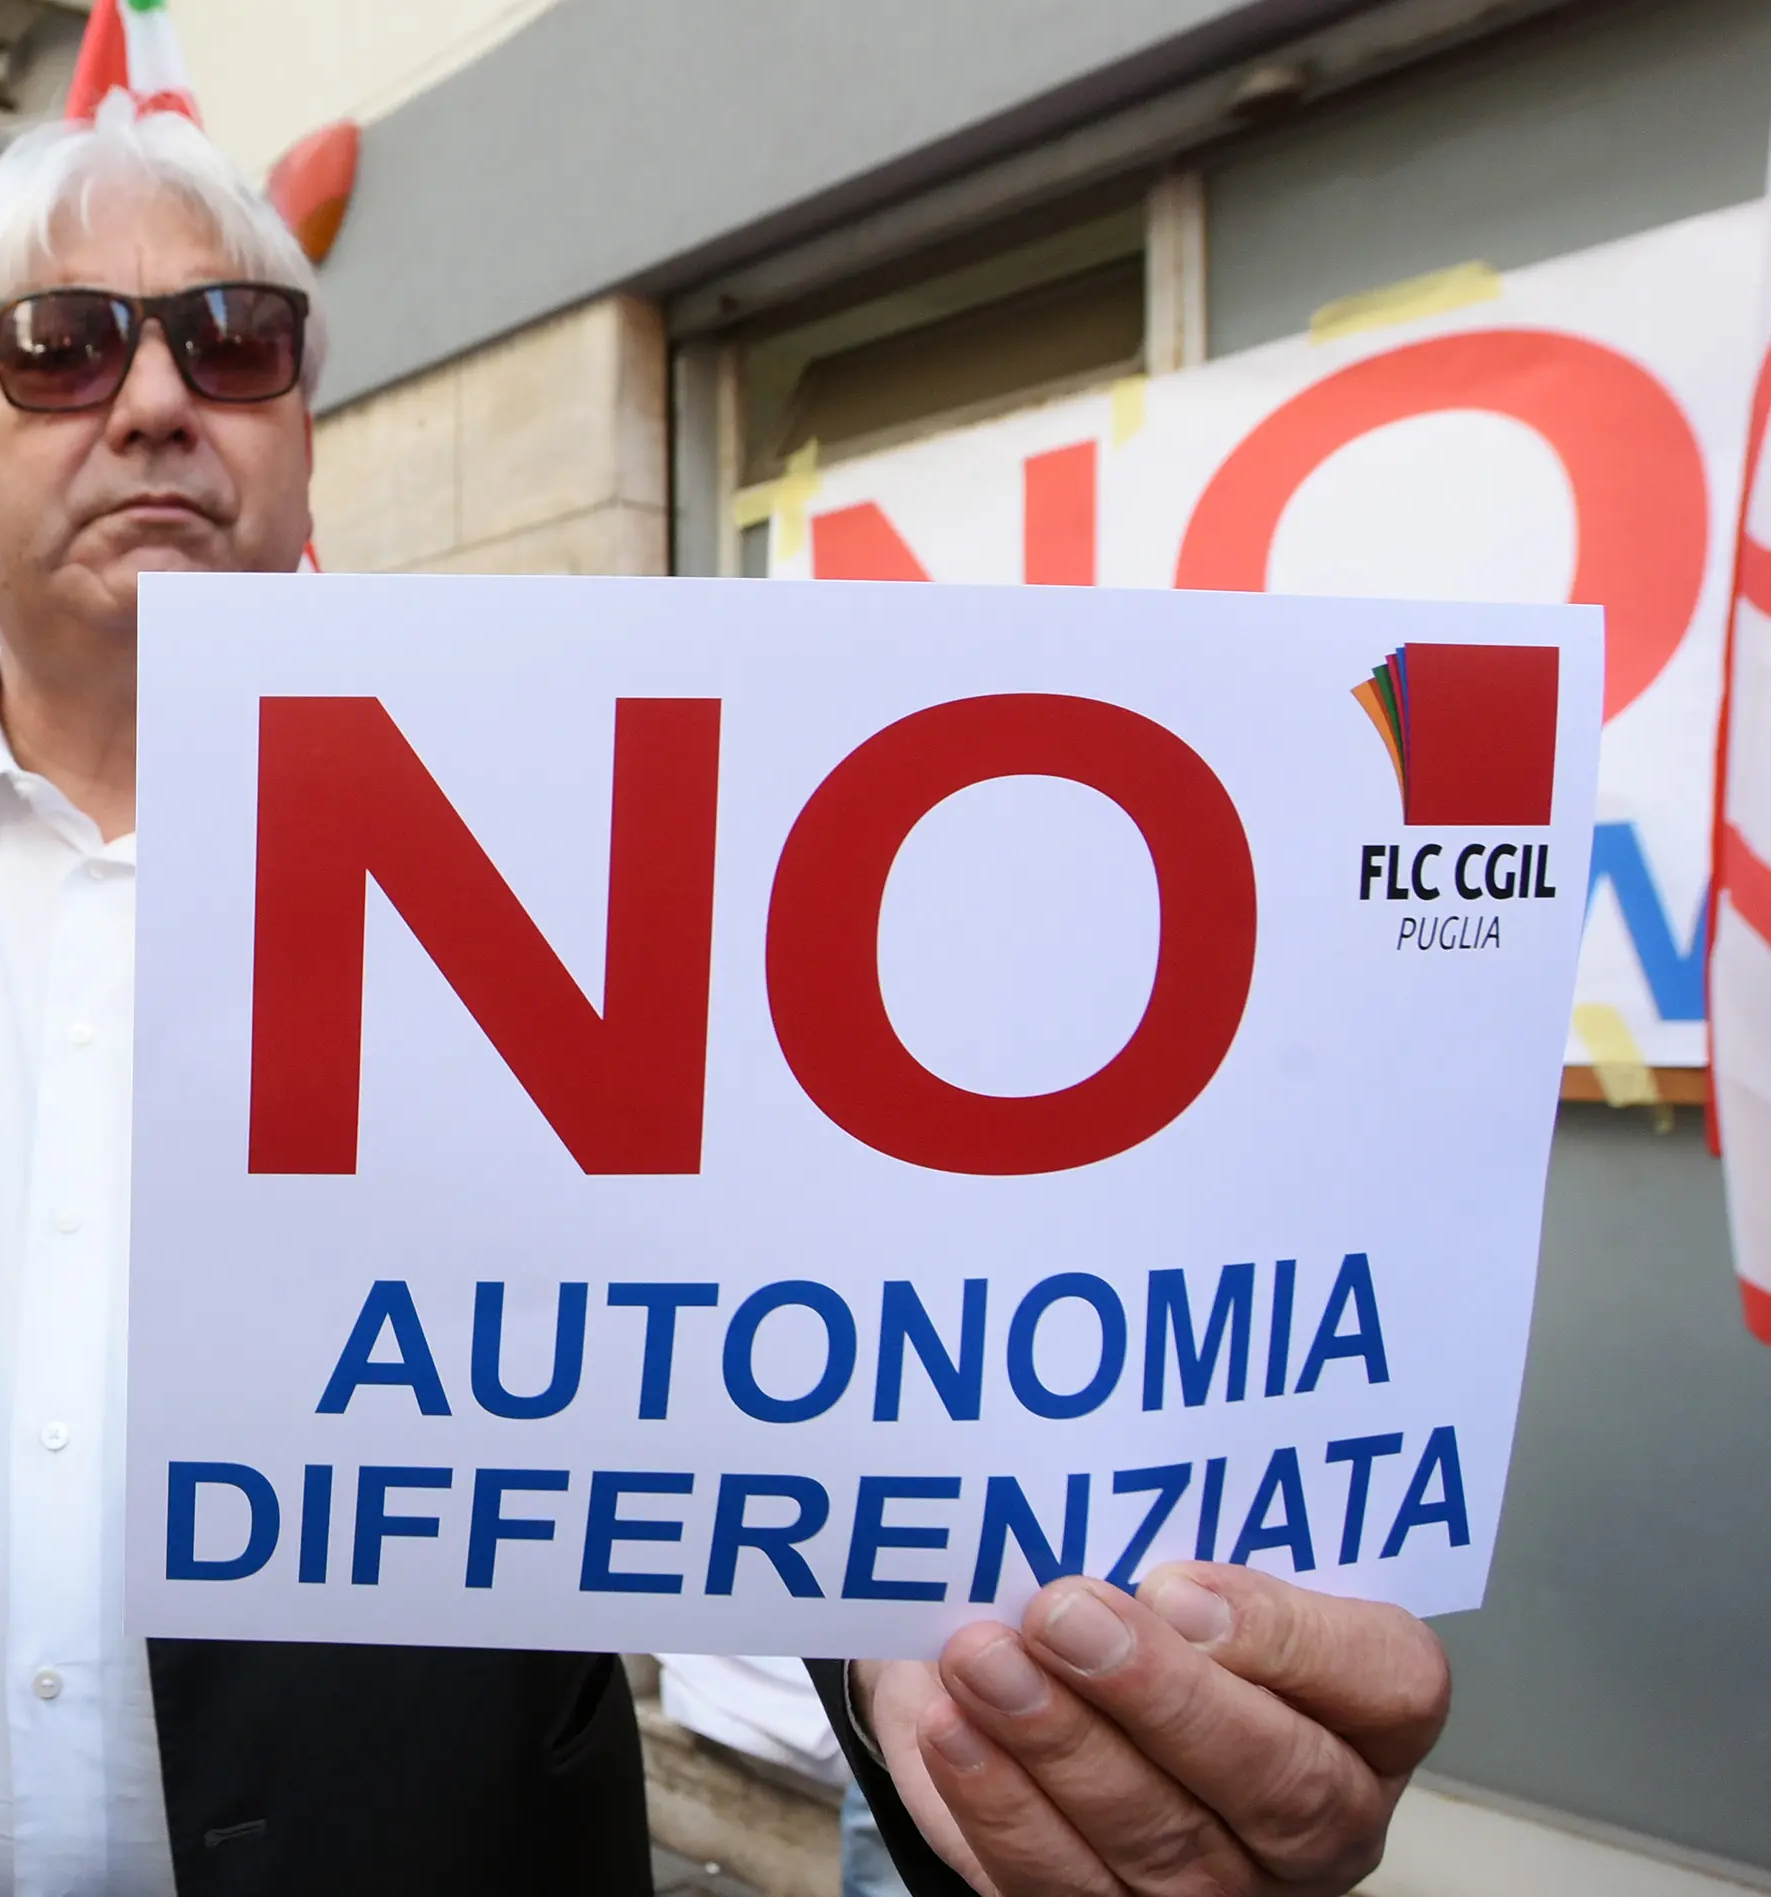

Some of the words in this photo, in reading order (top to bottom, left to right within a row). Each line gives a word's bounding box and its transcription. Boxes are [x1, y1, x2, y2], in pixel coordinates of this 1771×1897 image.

[248, 693, 1257, 1177] NO
[1359, 843, 1443, 901] FLC
[1454, 843, 1557, 900] CGIL
[1396, 915, 1501, 951] PUGLIA
[314, 1252, 1392, 1424] AUTONOMIA
[165, 1424, 1472, 1603] DIFFERENZIATA
